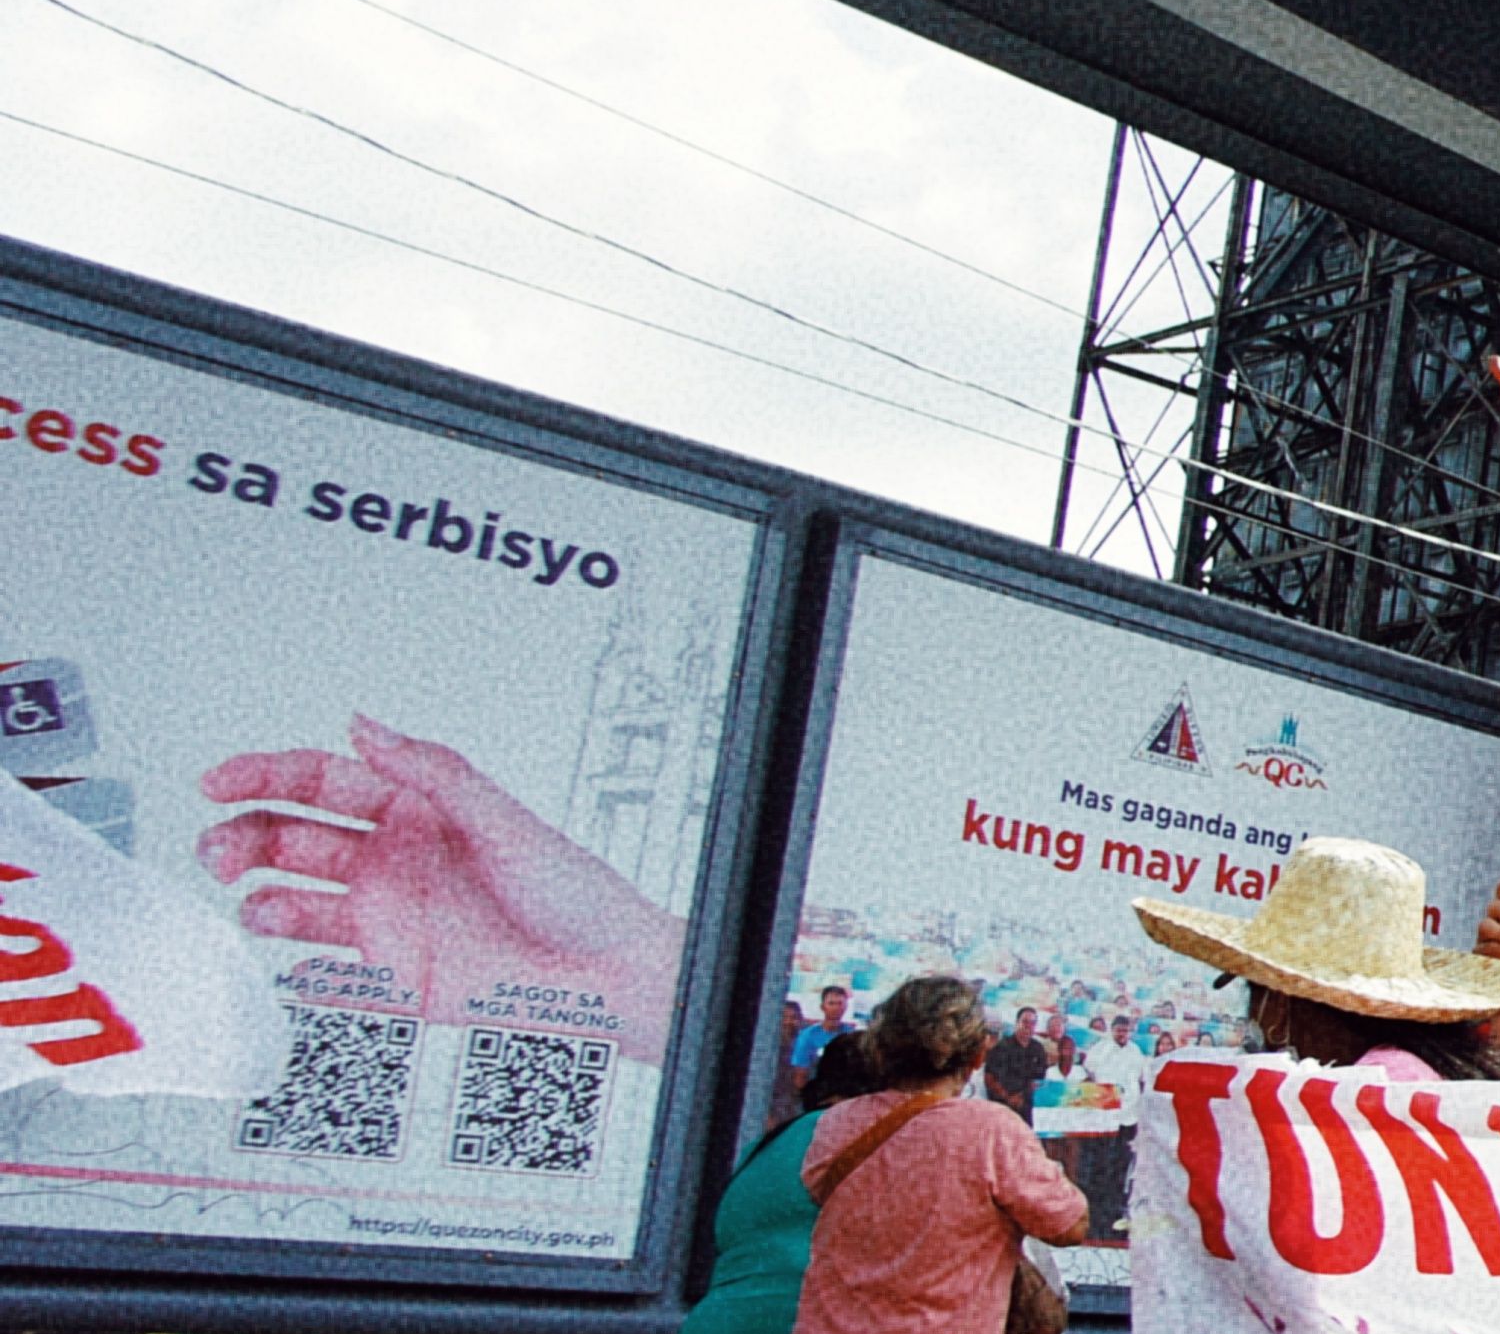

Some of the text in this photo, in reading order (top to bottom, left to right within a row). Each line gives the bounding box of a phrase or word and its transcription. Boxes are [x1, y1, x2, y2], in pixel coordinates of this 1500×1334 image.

[188, 452, 280, 507] sa
[306, 478, 620, 588] serbisyo
[1264, 758, 1304, 788] QC
[1060, 779, 1293, 855] Mas gaganda ang
[961, 799, 1086, 870] kung
[1100, 841, 1200, 897] may
[309, 958, 395, 983] PAANO
[494, 983, 605, 1009] SAGOT SA
[467, 998, 626, 1030] MGA TANONG:
